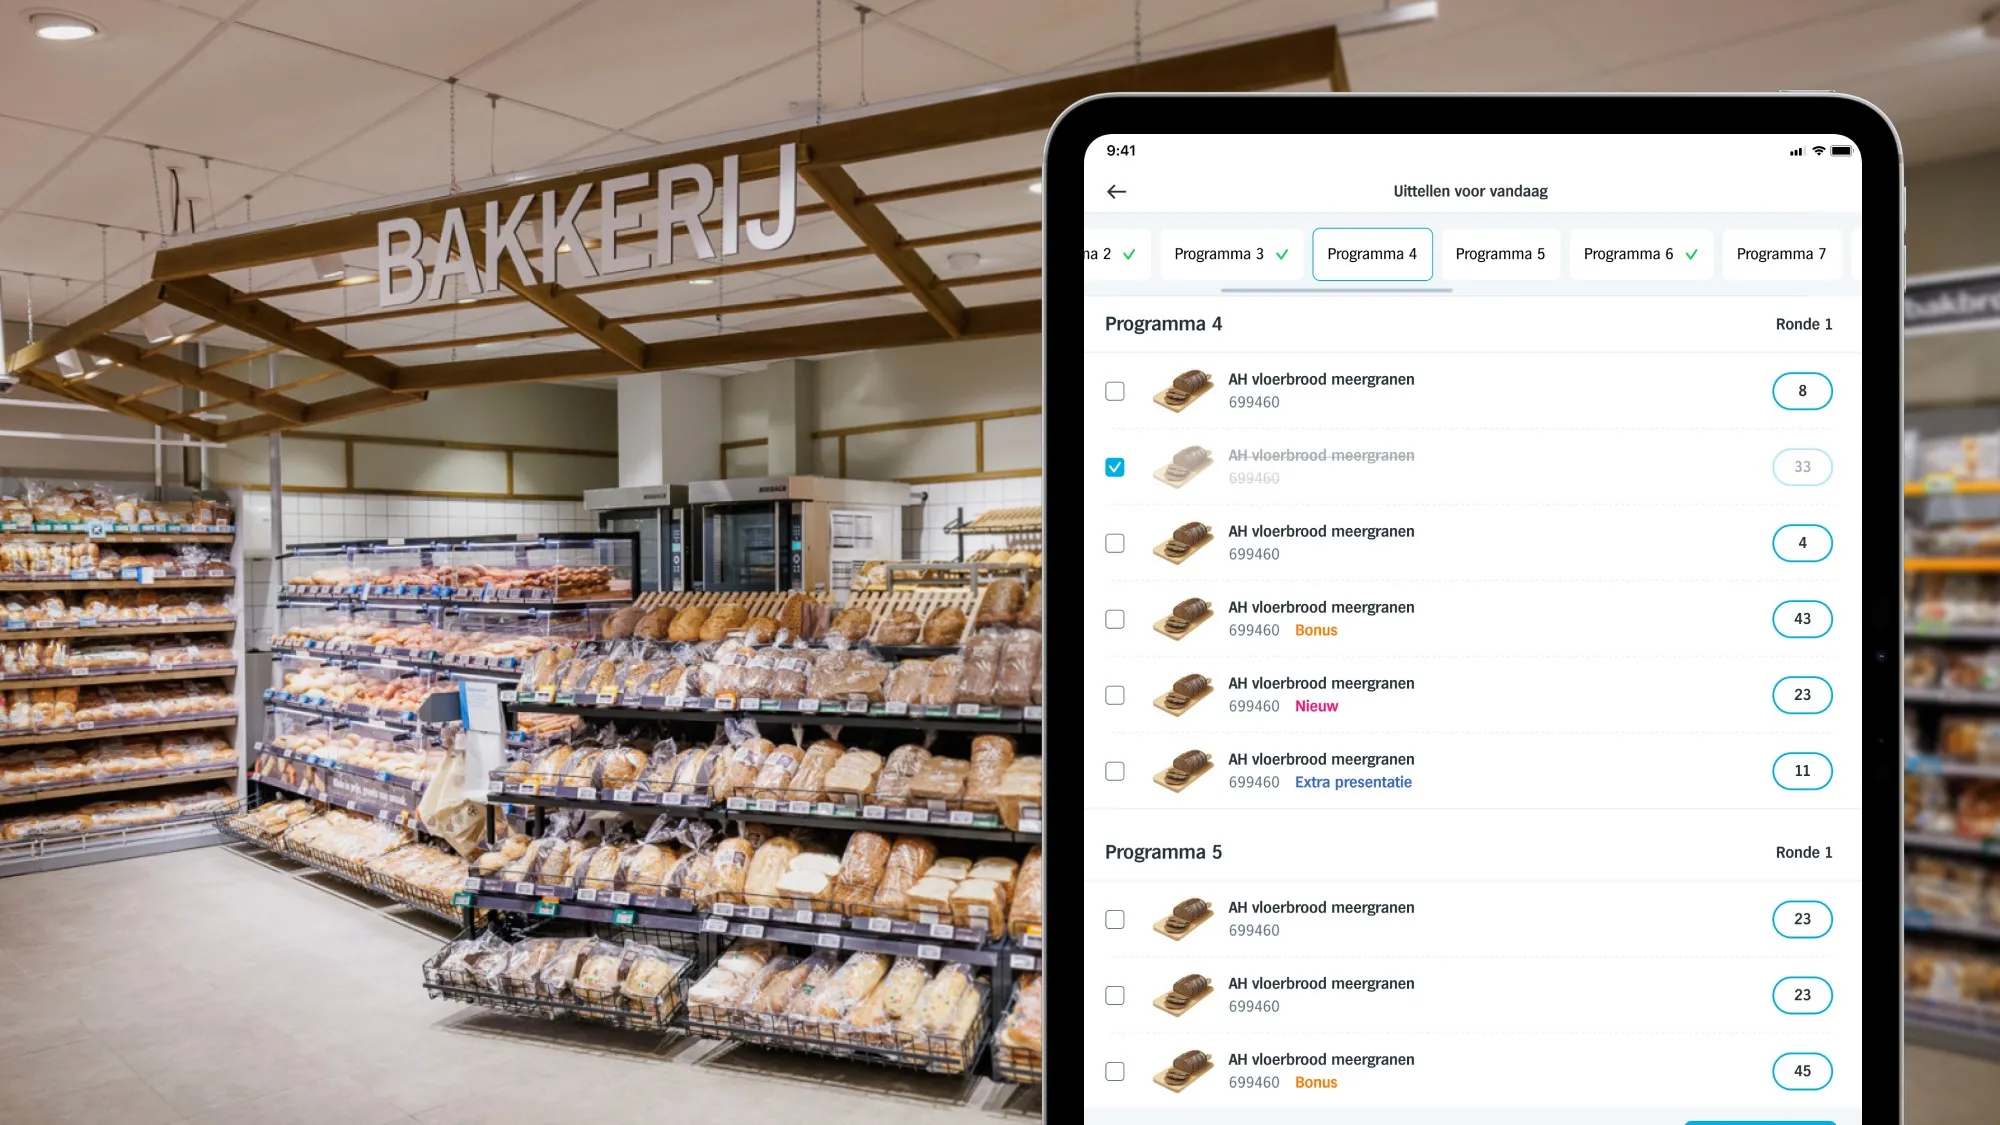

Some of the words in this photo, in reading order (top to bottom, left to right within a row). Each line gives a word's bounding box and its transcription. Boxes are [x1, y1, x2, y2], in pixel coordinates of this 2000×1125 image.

[1106, 144, 1136, 157] 9:41
[1393, 183, 1451, 198] Uittellen
[1454, 187, 1487, 198] voor
[1489, 183, 1549, 201] vandaag
[378, 142, 798, 309] BAKKERIJ
[1102, 247, 1112, 261] 2
[1174, 247, 1251, 263] Programma
[1255, 247, 1264, 261] 3
[1327, 247, 1404, 263] Programma
[1408, 247, 1418, 261] 4
[1456, 247, 1533, 263] Programma
[1537, 247, 1546, 261] 5
[1584, 247, 1661, 263] Programma
[1665, 247, 1674, 261] 6
[1737, 247, 1814, 263] Programma
[1818, 247, 1827, 261] 7
[1105, 315, 1206, 335] Programma
[1211, 315, 1223, 332] 4
[1776, 316, 1821, 331] Ronde
[1825, 317, 1833, 331] 1
[1227, 372, 1248, 386] AH
[1251, 371, 1327, 386] vloerbrood
[1331, 375, 1415, 389] meergranen
[1798, 384, 1808, 398] 8
[1228, 395, 1280, 409] 699460
[1227, 448, 1248, 462] AH
[1251, 447, 1327, 462] vloerbrood
[1331, 451, 1415, 465] meergranen
[1794, 460, 1812, 474] 33
[1228, 471, 1280, 485] 699460
[1227, 524, 1248, 538] AH
[1251, 523, 1327, 538] vloerbrood
[1331, 527, 1415, 541] meergranen
[1798, 536, 1808, 550] 4
[1228, 547, 1280, 561] 699460
[1227, 600, 1248, 614] AH
[1251, 599, 1327, 614] vloerbrood
[1331, 603, 1415, 617] meergranen
[1793, 612, 1812, 626] 43
[1228, 623, 1280, 637] 699460
[1295, 623, 1339, 637] Bonus
[1227, 676, 1248, 690] AH
[1251, 675, 1327, 690] vloerbrood
[1331, 679, 1415, 693] meergranen
[1794, 688, 1812, 702] 23
[1228, 699, 1280, 713] 699460
[1295, 698, 1339, 713] Nieuw
[1227, 752, 1248, 766] AH
[1251, 751, 1327, 766] vloerbrood
[1331, 755, 1415, 769] meergranen
[1795, 764, 1811, 778] 11
[1228, 775, 1280, 789] 699460
[1295, 775, 1331, 789] Extra
[1334, 774, 1413, 791] presentatie
[1105, 844, 1206, 864] Programma
[1212, 844, 1223, 860] 5
[1776, 845, 1821, 859] Ronde
[1825, 846, 1833, 859] 1
[1227, 900, 1248, 914] AH
[1251, 899, 1327, 914] vloerbrood
[1331, 903, 1415, 917] meergranen
[1794, 912, 1812, 926] 23
[1228, 923, 1280, 937] 699460
[1227, 976, 1248, 990] AH
[1251, 975, 1327, 990] vloerbrood
[1331, 979, 1415, 993] meergranen
[1794, 988, 1812, 1002] 23
[1228, 999, 1280, 1013] 699460
[1227, 1052, 1248, 1066] AH
[1251, 1051, 1327, 1066] vloerbrood
[1331, 1055, 1415, 1069] meergranen
[1793, 1064, 1812, 1078] 45
[1228, 1075, 1280, 1089] 699460
[1295, 1075, 1338, 1089] Bonus
